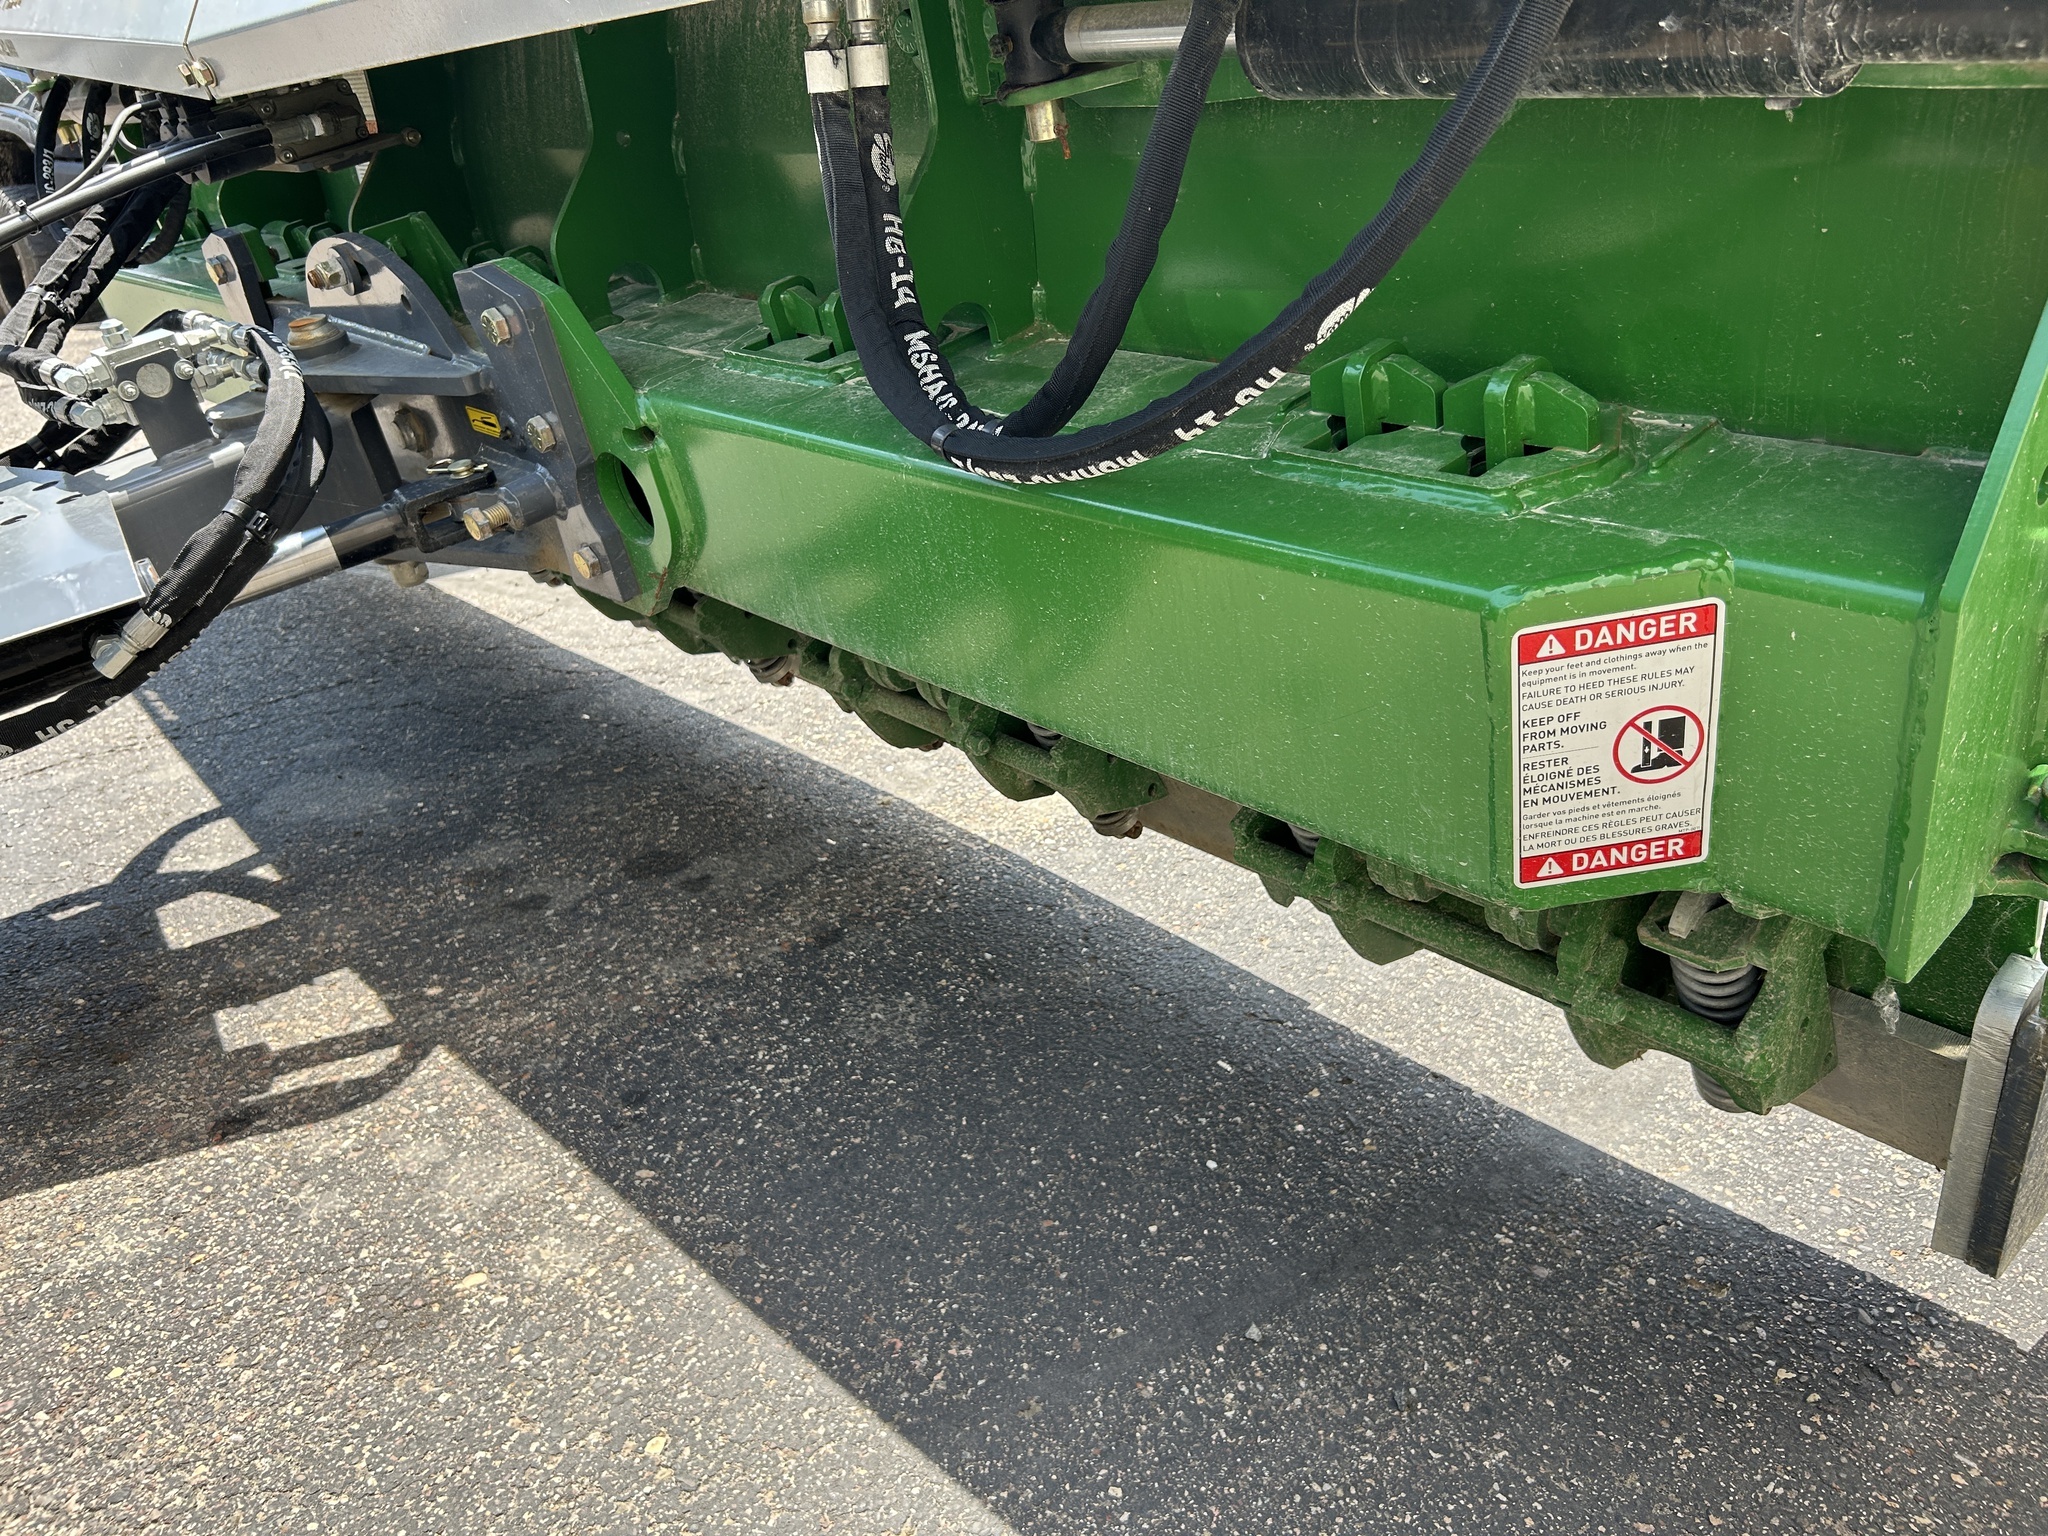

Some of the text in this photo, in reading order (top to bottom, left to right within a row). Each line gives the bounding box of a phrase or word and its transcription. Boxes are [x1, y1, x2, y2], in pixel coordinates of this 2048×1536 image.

[882, 213, 917, 309] HG-14
[903, 329, 948, 401] MSHA
[1574, 611, 1697, 651] DANGER
[1520, 662, 1637, 688] equipment is in movement.
[1521, 641, 1709, 678] Keep your feet and clothings away when the
[1521, 664, 1695, 701] FAILURE TO HEED THESE RULES MAY
[1521, 678, 1685, 712] CAUSE DEATH OR SERIOUS INJURY.
[1521, 710, 1581, 729] KEEP OFF
[1522, 720, 1607, 743] FROM MOVING
[1522, 739, 1565, 754] PARTS.
[1522, 756, 1569, 772] RESTER
[1522, 763, 1600, 785] ÉLOIGNÉ DES
[1522, 775, 1602, 796] MÉCANISMES
[1522, 785, 1621, 809] EN MOUVEMENT.
[1522, 790, 1682, 821] Garder vos pieds et vêtements éloignés
[1522, 820, 1554, 830] lorsque
[1564, 813, 1600, 824] machine
[1600, 810, 1614, 818] est
[1615, 808, 1626, 816] en
[1627, 803, 1661, 814] marche.
[1522, 806, 1702, 842] ENFREINDRE CES RÈGLES PEUT CAUSER
[1522, 819, 1693, 852] LA MORT OU DES BLESSURES GRAVES.
[1571, 837, 1685, 872] DANGER
